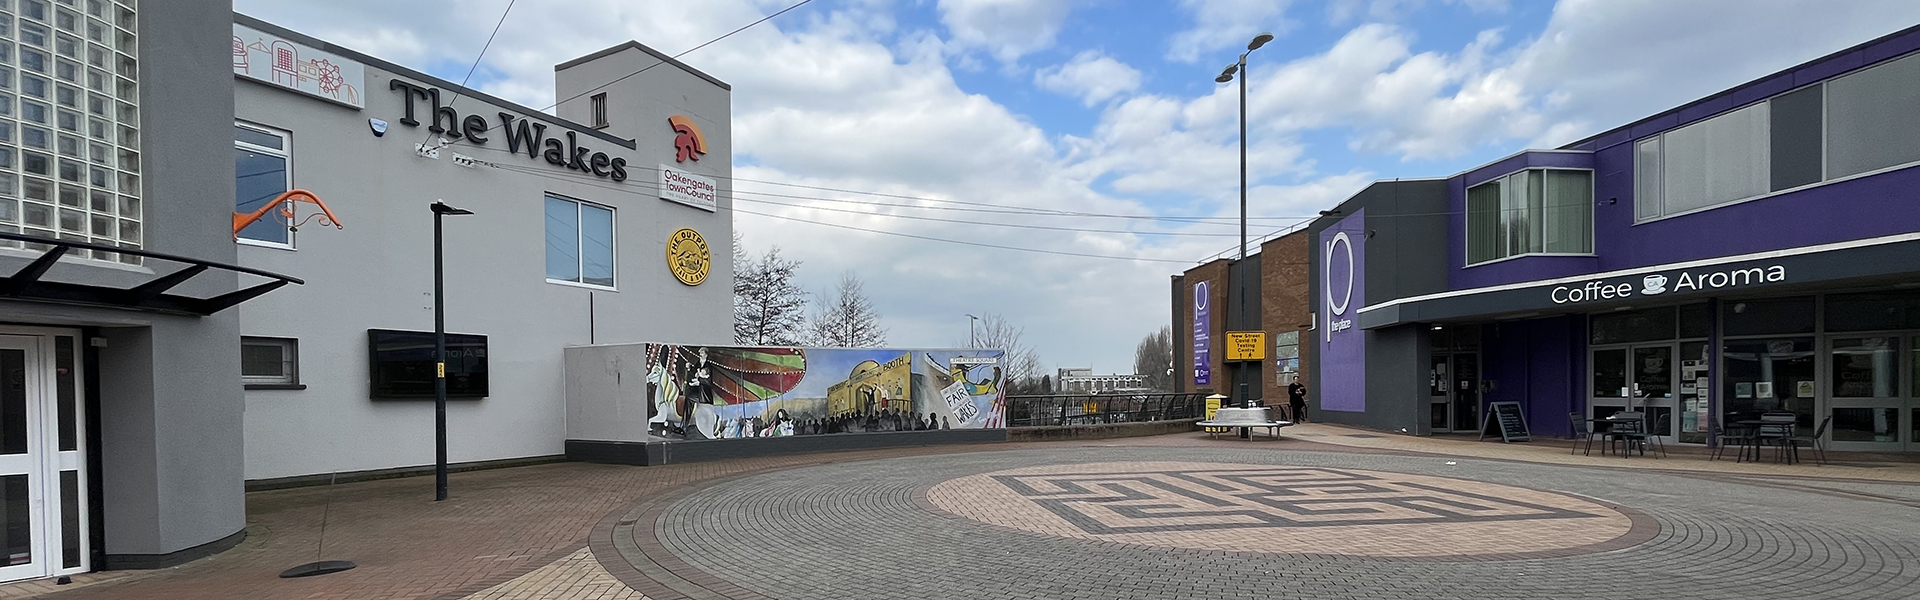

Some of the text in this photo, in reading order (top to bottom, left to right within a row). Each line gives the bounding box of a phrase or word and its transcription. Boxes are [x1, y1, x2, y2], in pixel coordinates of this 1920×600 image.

[390, 79, 627, 182] The Wakes
[664, 169, 715, 192] Oakengates
[670, 231, 709, 262] THE OUTPOST
[1551, 265, 1785, 304] Coffee Aroma
[1331, 319, 1352, 333] the place
[883, 356, 904, 371] BOOTH
[945, 387, 968, 407] FAIR
[953, 400, 978, 424] WAKES
